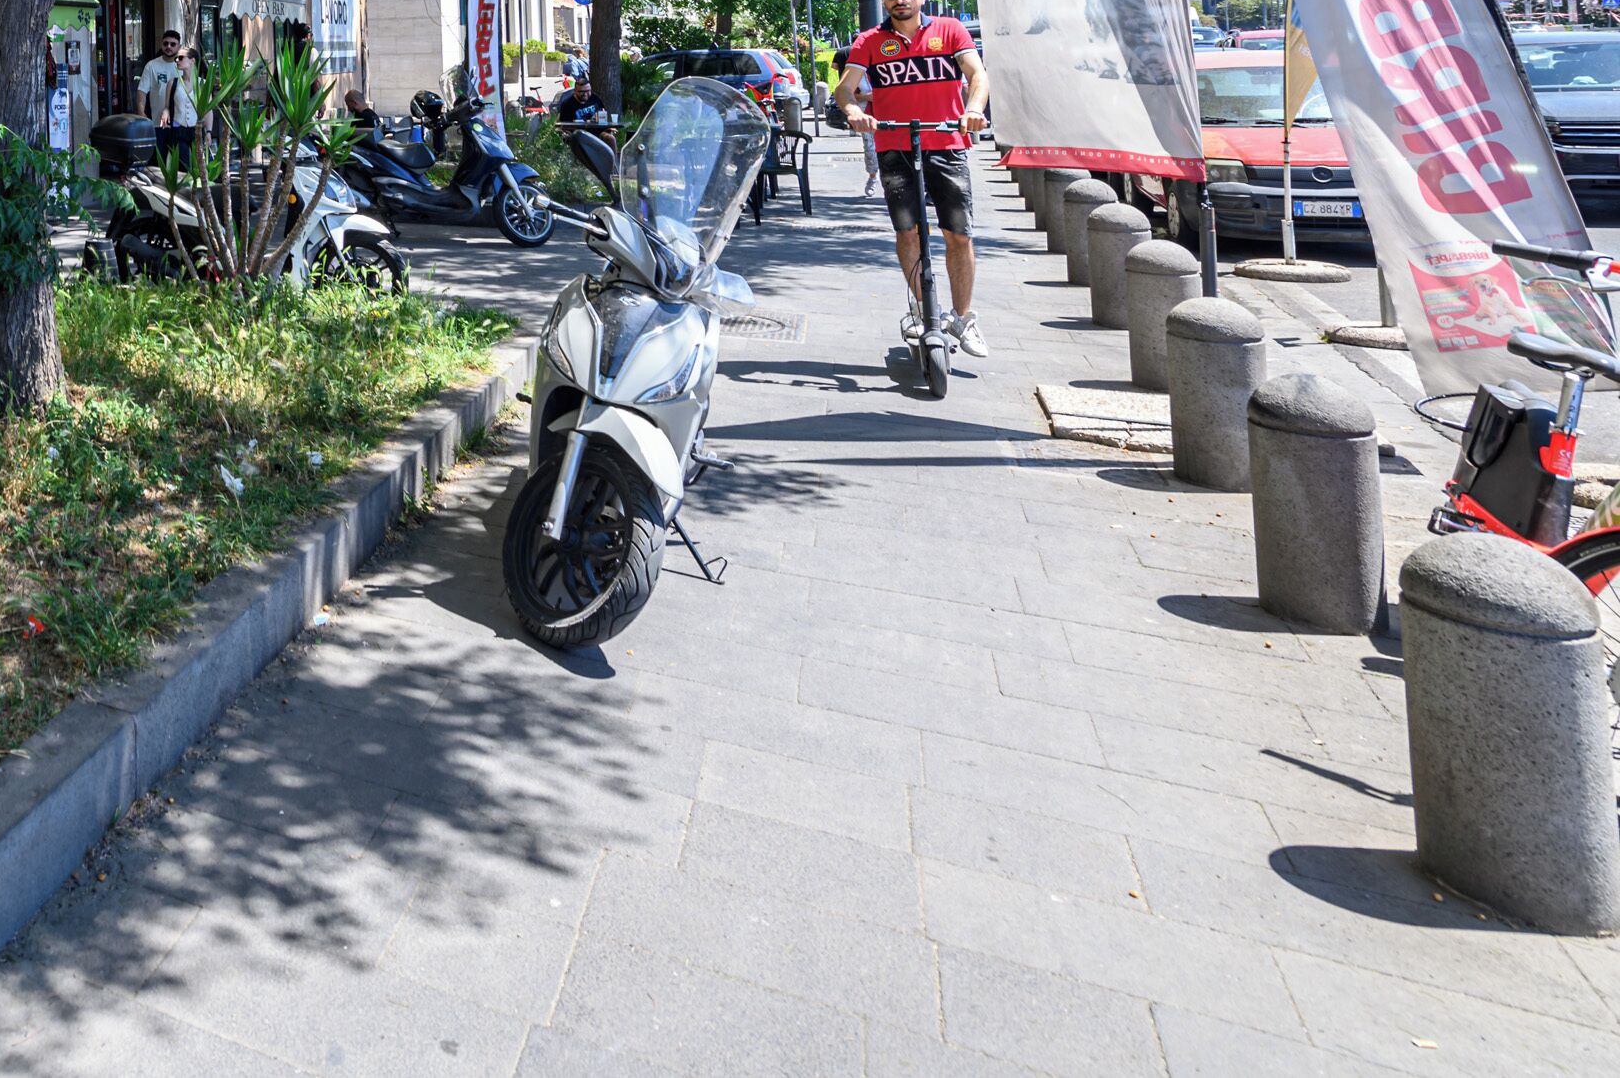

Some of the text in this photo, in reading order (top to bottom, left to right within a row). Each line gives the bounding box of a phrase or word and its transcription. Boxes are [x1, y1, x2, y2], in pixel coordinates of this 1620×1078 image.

[252, 0, 285, 16] OPEN BAR
[876, 56, 957, 86] SPAIN
